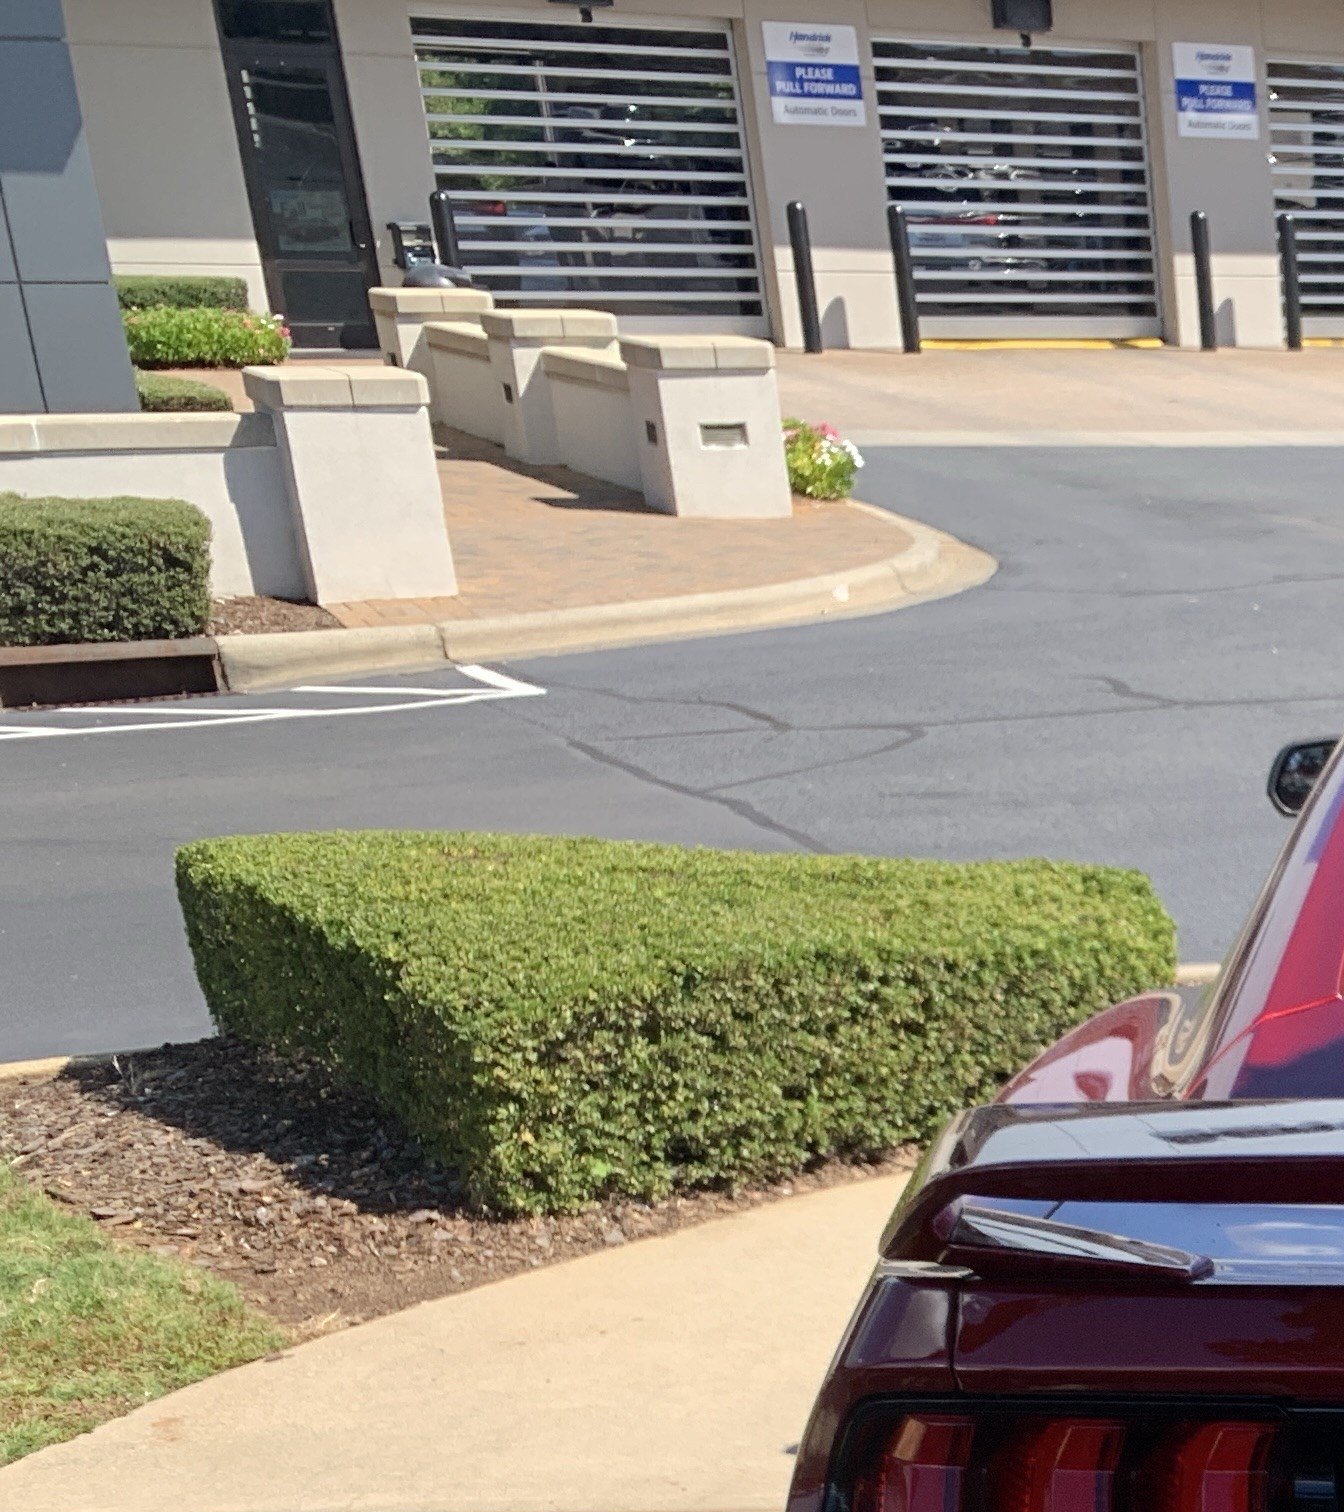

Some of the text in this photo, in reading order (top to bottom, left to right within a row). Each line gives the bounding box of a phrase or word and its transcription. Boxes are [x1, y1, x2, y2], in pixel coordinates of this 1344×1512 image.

[795, 67, 834, 80] PLEASE
[775, 81, 857, 95] PULL FORWARD
[1199, 85, 1233, 97] PLEASE
[783, 104, 858, 117] Automatic Doors
